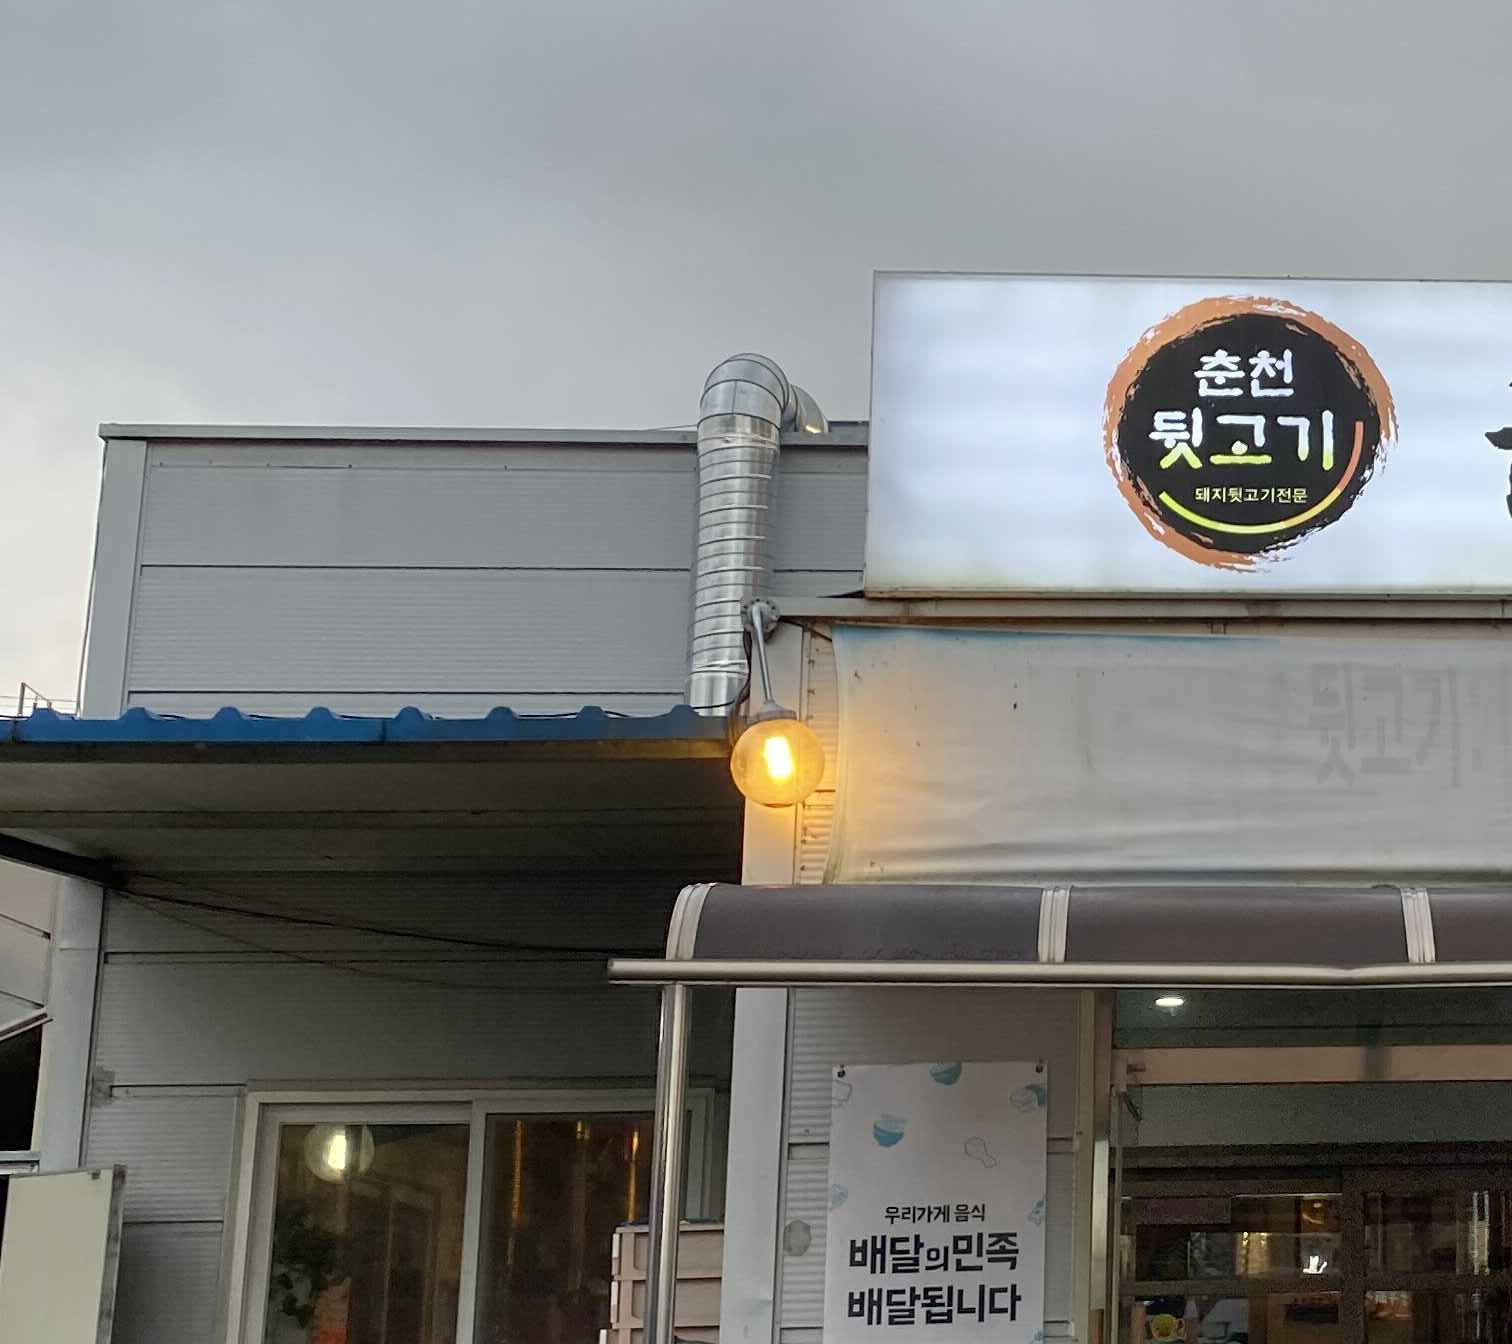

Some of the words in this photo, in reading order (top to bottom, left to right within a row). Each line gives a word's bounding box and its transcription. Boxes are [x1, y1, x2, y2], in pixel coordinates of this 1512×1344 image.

[1194, 349, 1295, 397] 춘천
[1149, 407, 1335, 471] 뒷고기
[1194, 487, 1308, 504] 돼지뒷고기전문
[885, 1205, 950, 1224] 우리가게
[954, 1204, 986, 1222] 음식
[849, 1232, 1019, 1274] 배달의민족
[848, 1283, 1022, 1326] 배달됩니다
